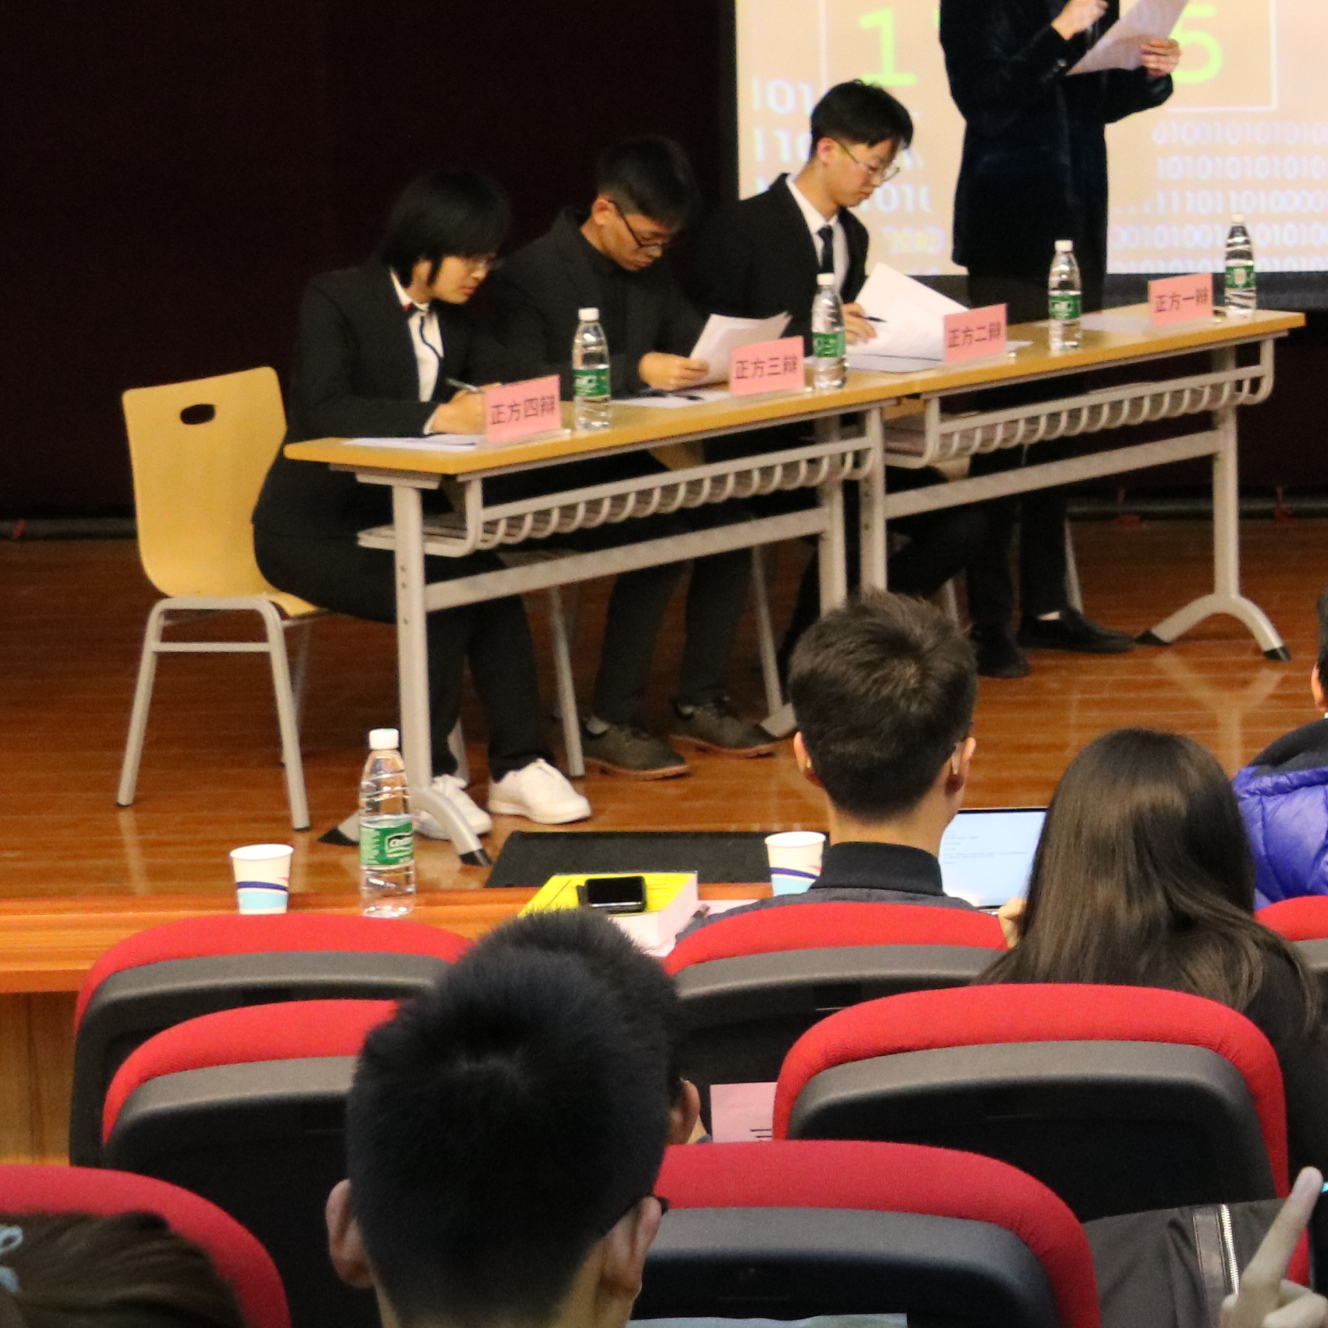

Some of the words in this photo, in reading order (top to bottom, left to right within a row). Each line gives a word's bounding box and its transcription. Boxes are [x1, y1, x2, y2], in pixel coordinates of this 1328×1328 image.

[1154, 285, 1210, 313] 正方一辩
[947, 320, 1002, 349] 正方二辩
[734, 354, 798, 382] 正方三辩
[490, 393, 557, 426] 正方四辩
